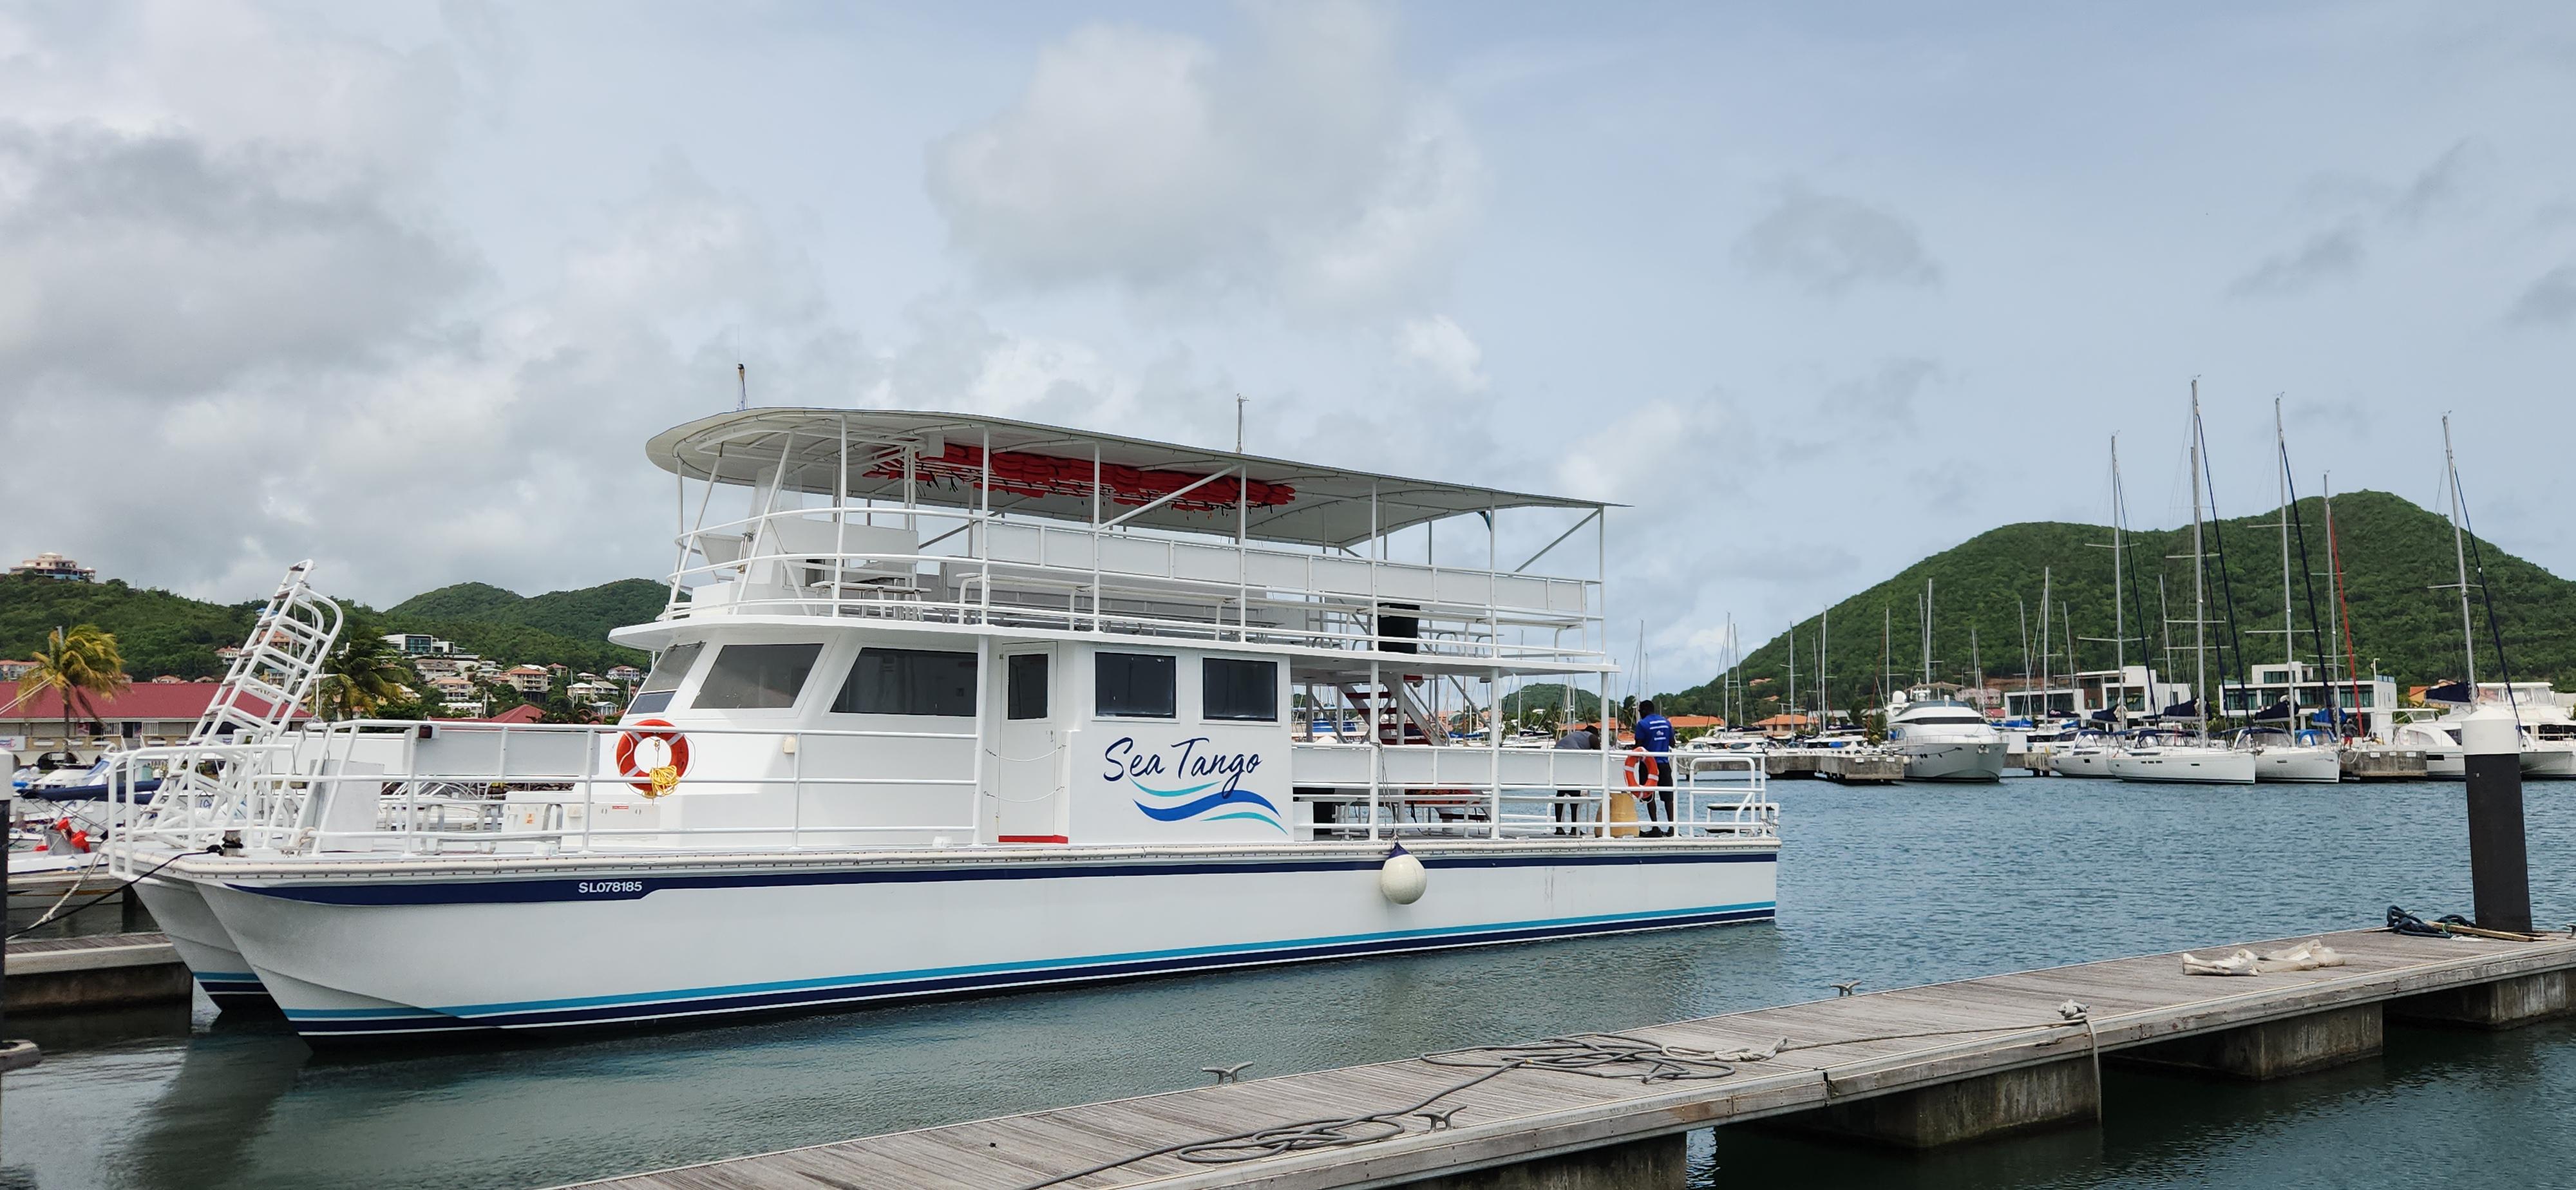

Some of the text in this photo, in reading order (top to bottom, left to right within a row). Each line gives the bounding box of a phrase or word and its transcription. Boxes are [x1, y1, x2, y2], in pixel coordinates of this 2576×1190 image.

[1103, 737, 1262, 799] Sea Tango
[578, 881, 643, 894] SL078185
